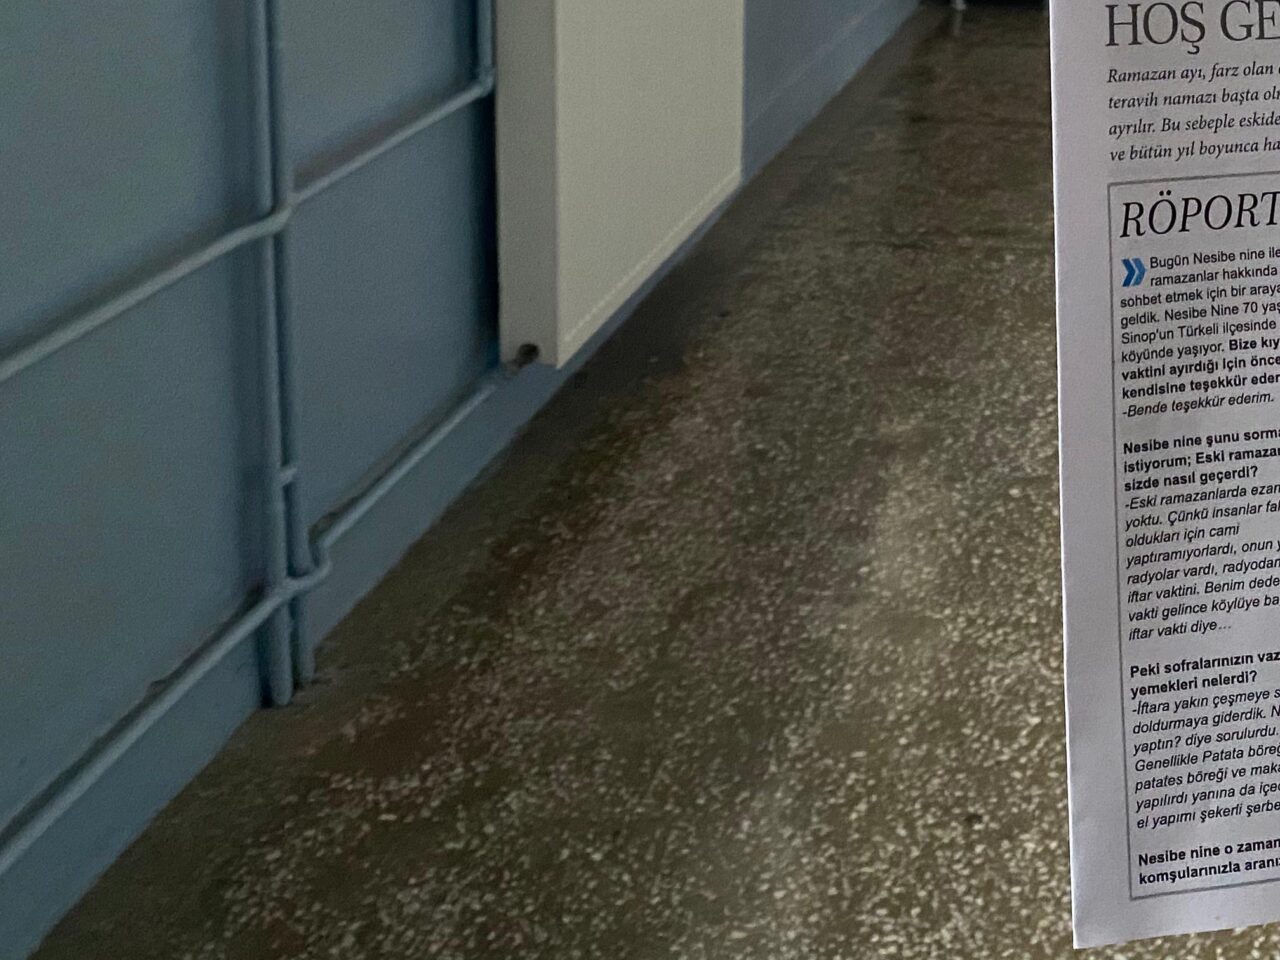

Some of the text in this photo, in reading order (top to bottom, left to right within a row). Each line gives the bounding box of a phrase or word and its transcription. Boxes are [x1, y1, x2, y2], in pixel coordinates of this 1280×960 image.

[1105, 1, 1206, 55] HOŞ
[1107, 68, 1176, 83] Ramazan
[1180, 68, 1206, 84] ayı,
[1208, 62, 1239, 83] farz
[1243, 60, 1274, 77] olan
[1108, 91, 1158, 109] teravih
[1163, 93, 1217, 106] namazı
[1221, 88, 1259, 106] başta
[1109, 118, 1156, 140] ayrılır.
[1160, 117, 1181, 132] Bu
[1185, 113, 1235, 134] sebeple
[1110, 150, 1126, 161] ve
[1129, 144, 1172, 160] bütün
[1175, 140, 1195, 162] yıl
[1199, 140, 1259, 159] boyunca
[1150, 255, 1189, 270] Bugün
[1193, 251, 1236, 264] Nesibe
[1239, 248, 1265, 261] nine
[1150, 264, 1278, 287] ramazanlar hakkında
[1120, 292, 1162, 308] sohbet
[1165, 288, 1203, 303] etmek
[1206, 286, 1228, 302] için
[1230, 284, 1247, 297] bir
[1120, 311, 1160, 330] geldik.
[1164, 306, 1207, 321] Nesibe
[1211, 304, 1239, 317] Nine
[1242, 301, 1258, 314] 70
[1138, 849, 1186, 867] Nesibe
[1190, 845, 1220, 859] nine
[1224, 845, 1233, 854] o
[1139, 861, 1241, 885] komşularınızla
